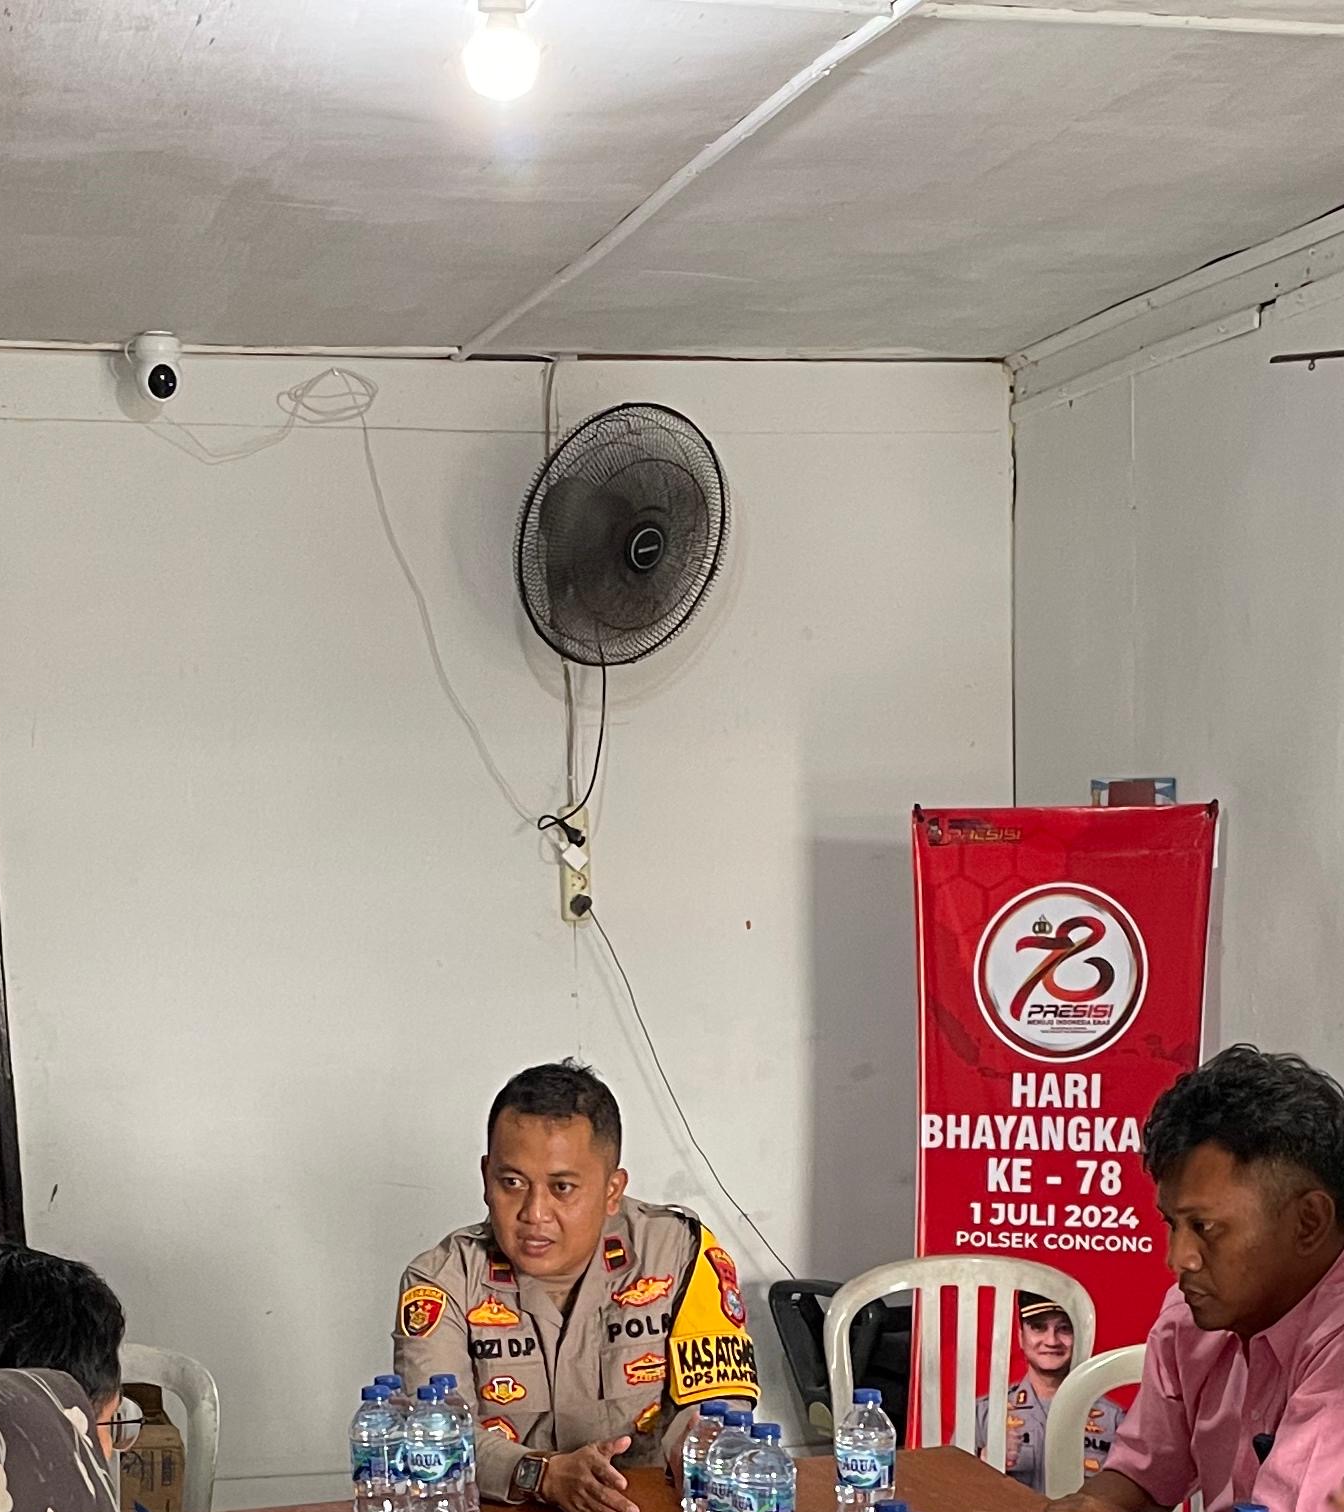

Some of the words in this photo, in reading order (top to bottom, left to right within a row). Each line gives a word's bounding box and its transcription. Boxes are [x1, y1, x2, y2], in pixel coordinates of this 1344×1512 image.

[1009, 915, 1116, 1022] 78
[1027, 1003, 1115, 1019] PRESISI
[1011, 1072, 1101, 1109] HARI
[920, 1115, 1142, 1152] BHAYANGKA
[986, 1158, 1033, 1194] KE
[1077, 1160, 1124, 1196] 78
[969, 1203, 981, 1227] 1
[989, 1202, 1057, 1228] JULI
[1065, 1204, 1140, 1229] 2024
[955, 1230, 1040, 1251] POLSEK
[1042, 1231, 1153, 1253] CONCONG
[682, 1371, 714, 1389] OPS
[716, 1368, 758, 1384] MANT
[841, 1456, 878, 1475] AQUA
